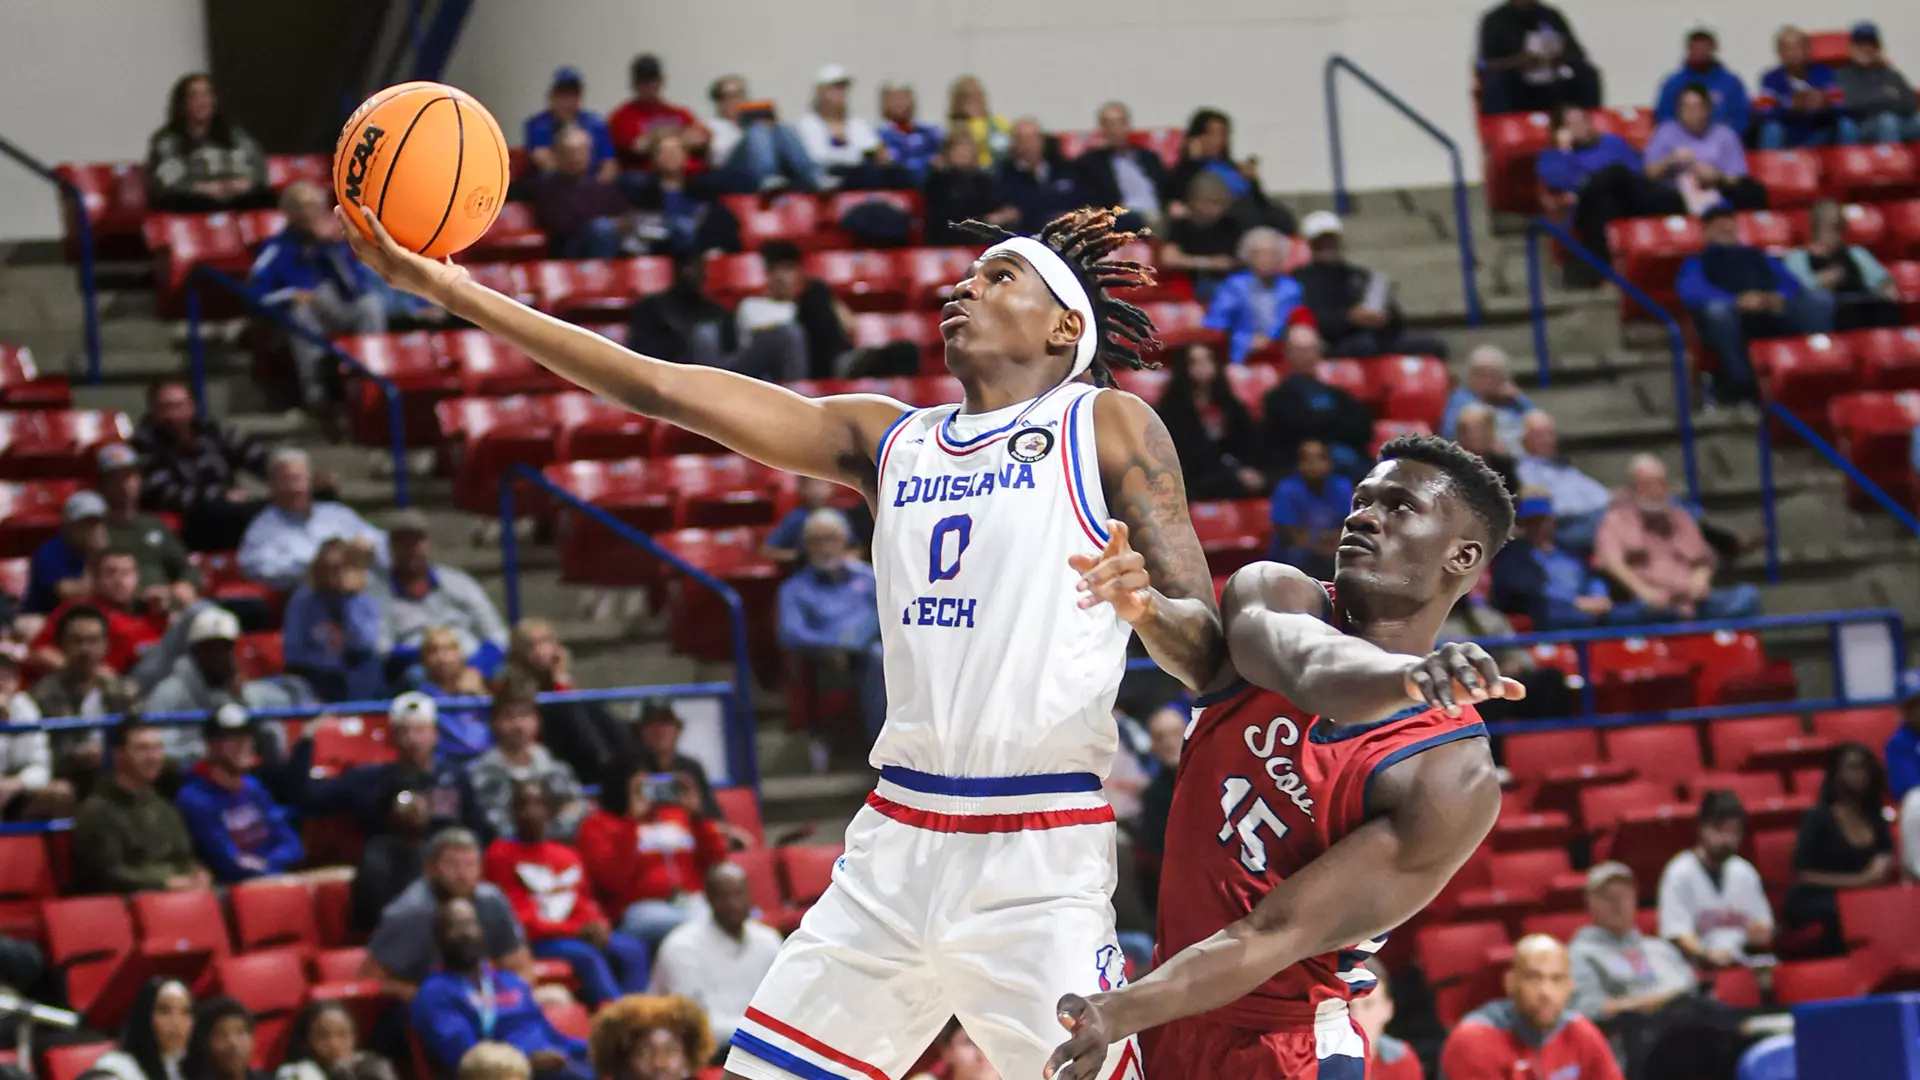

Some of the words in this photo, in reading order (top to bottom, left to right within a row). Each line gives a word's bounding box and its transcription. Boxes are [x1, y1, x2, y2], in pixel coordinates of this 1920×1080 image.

[345, 125, 385, 208] NCAA
[893, 463, 1035, 507] LOUISIANA
[928, 513, 973, 584] 0
[1217, 775, 1291, 876] 15
